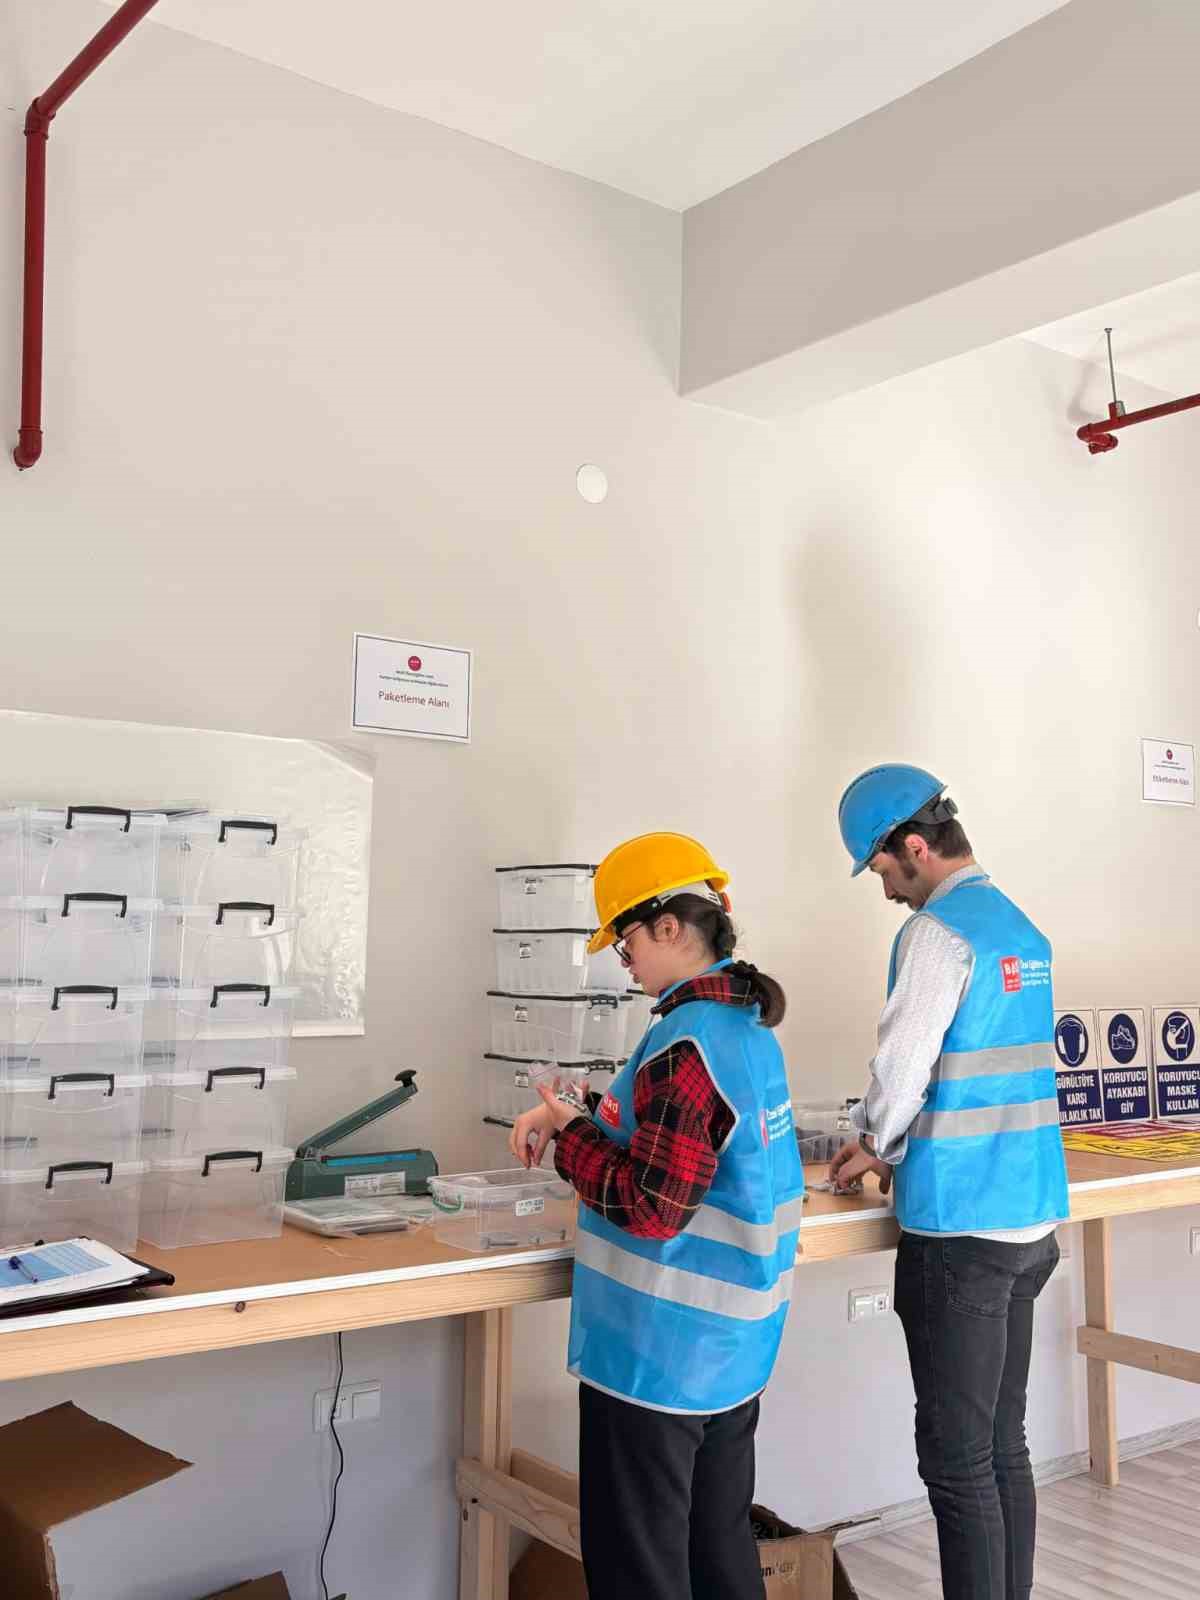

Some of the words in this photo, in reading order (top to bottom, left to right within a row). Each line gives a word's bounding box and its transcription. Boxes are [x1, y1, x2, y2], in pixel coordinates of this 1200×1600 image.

[378, 690, 426, 706] Paketleme
[428, 697, 450, 709] Alanı
[1103, 1070, 1147, 1084] KORUYUCU
[1106, 1086, 1146, 1099] AYAKKABI
[1167, 1084, 1197, 1097] MASKE
[1066, 1092, 1088, 1106] KARŞI
[1166, 1098, 1199, 1111] KULLAN
[1120, 1100, 1135, 1114] GİY
[1058, 1108, 1088, 1123] ULAKLIK
[1088, 1107, 1102, 1120] TAK
